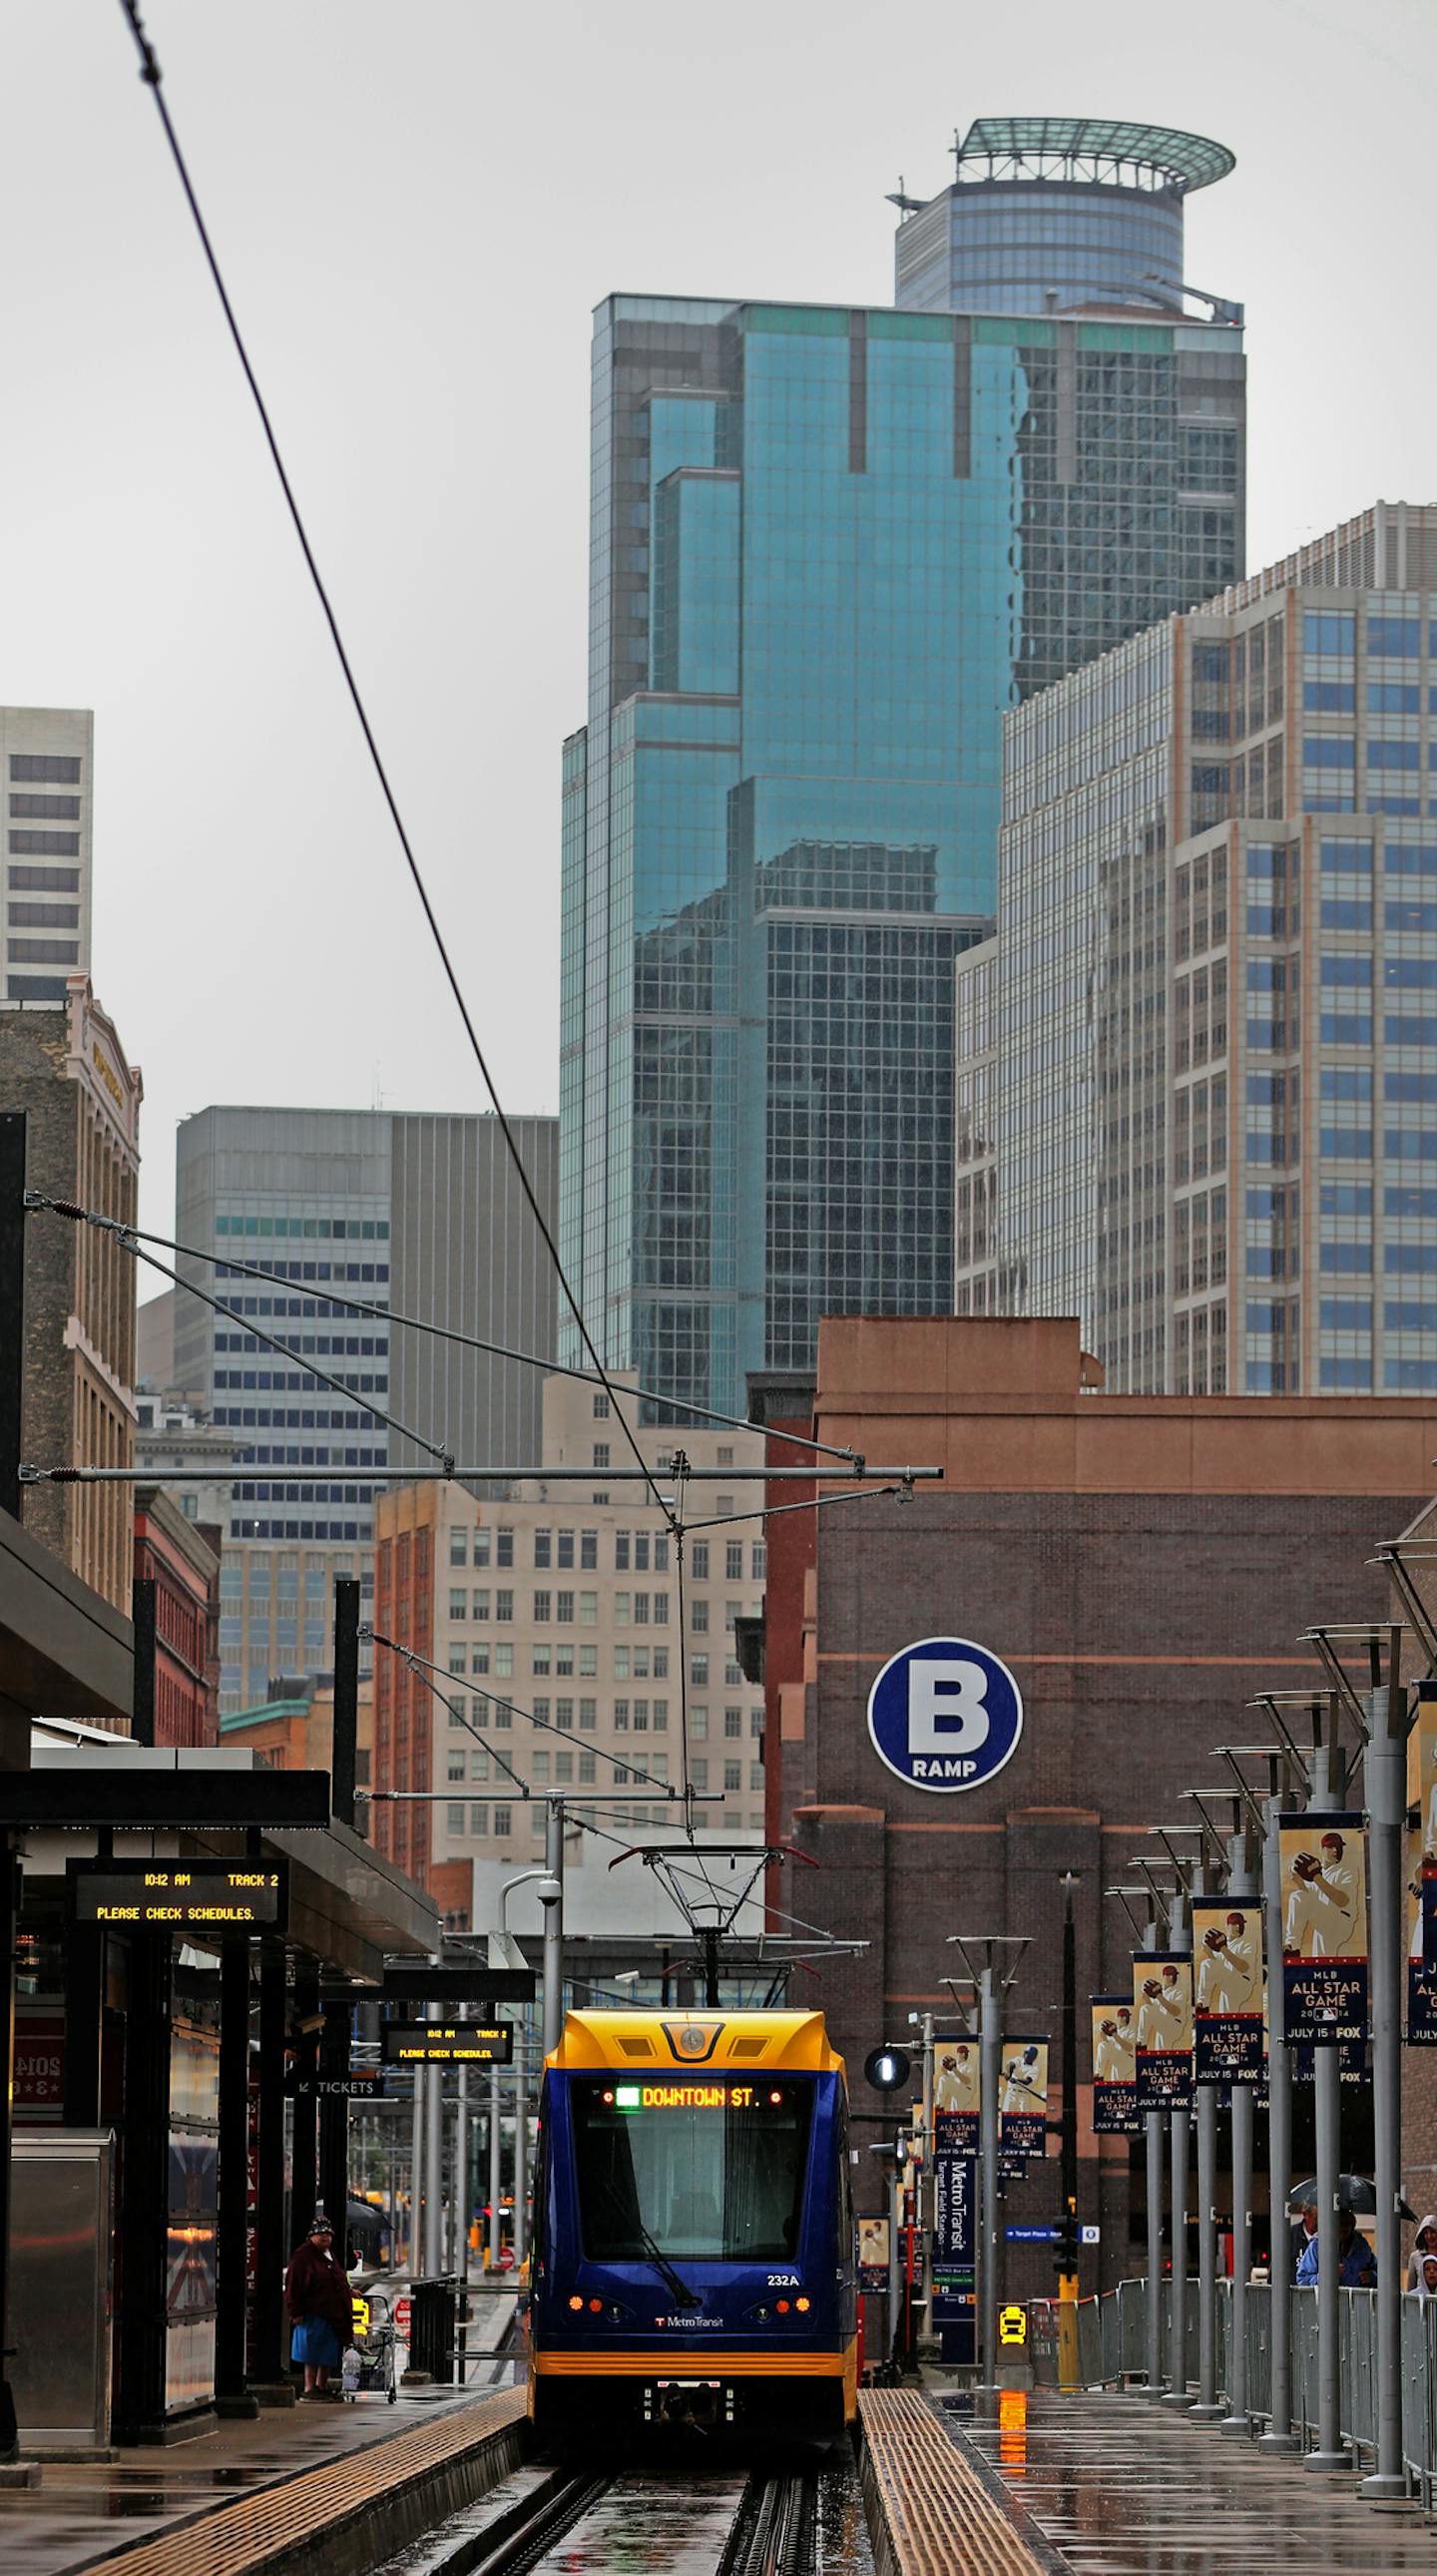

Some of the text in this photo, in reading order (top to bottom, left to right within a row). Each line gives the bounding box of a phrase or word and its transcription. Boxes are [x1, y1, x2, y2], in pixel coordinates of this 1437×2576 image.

[908, 1659, 990, 1754] B
[913, 1760, 977, 1778] RAMP
[144, 1874, 278, 1887] 10:12 AM TRACK 2
[97, 1907, 254, 1920] PLEASE CHECK SCHEDULES.
[1313, 1971, 1338, 1980] MLB
[1292, 1982, 1361, 1994] ALL STAR
[1417, 1984, 1437, 1995] AL
[1305, 1995, 1347, 2007] GAME
[476, 2030, 499, 2039] TRACK
[1202, 2033, 1258, 2043] ALL STAR
[1287, 2027, 1361, 2039] JULY 15 FOX
[399, 2050, 425, 2058] PLEASE
[428, 2050, 450, 2058] CHECK
[1213, 2044, 1247, 2053] GAME
[1141, 2067, 1188, 2076] ALL STAR
[1238, 2069, 1258, 2079] FOX
[1150, 2076, 1179, 2085] GAME
[1340, 2073, 1360, 2082] FOX
[317, 2082, 374, 2093] TICKETS
[643, 2087, 759, 2106] DOWNTOWN ST.
[1171, 2098, 1188, 2106] FOX
[938, 2190, 947, 2212] Field
[938, 2214, 947, 2244] Station
[767, 2275, 799, 2286] 232A
